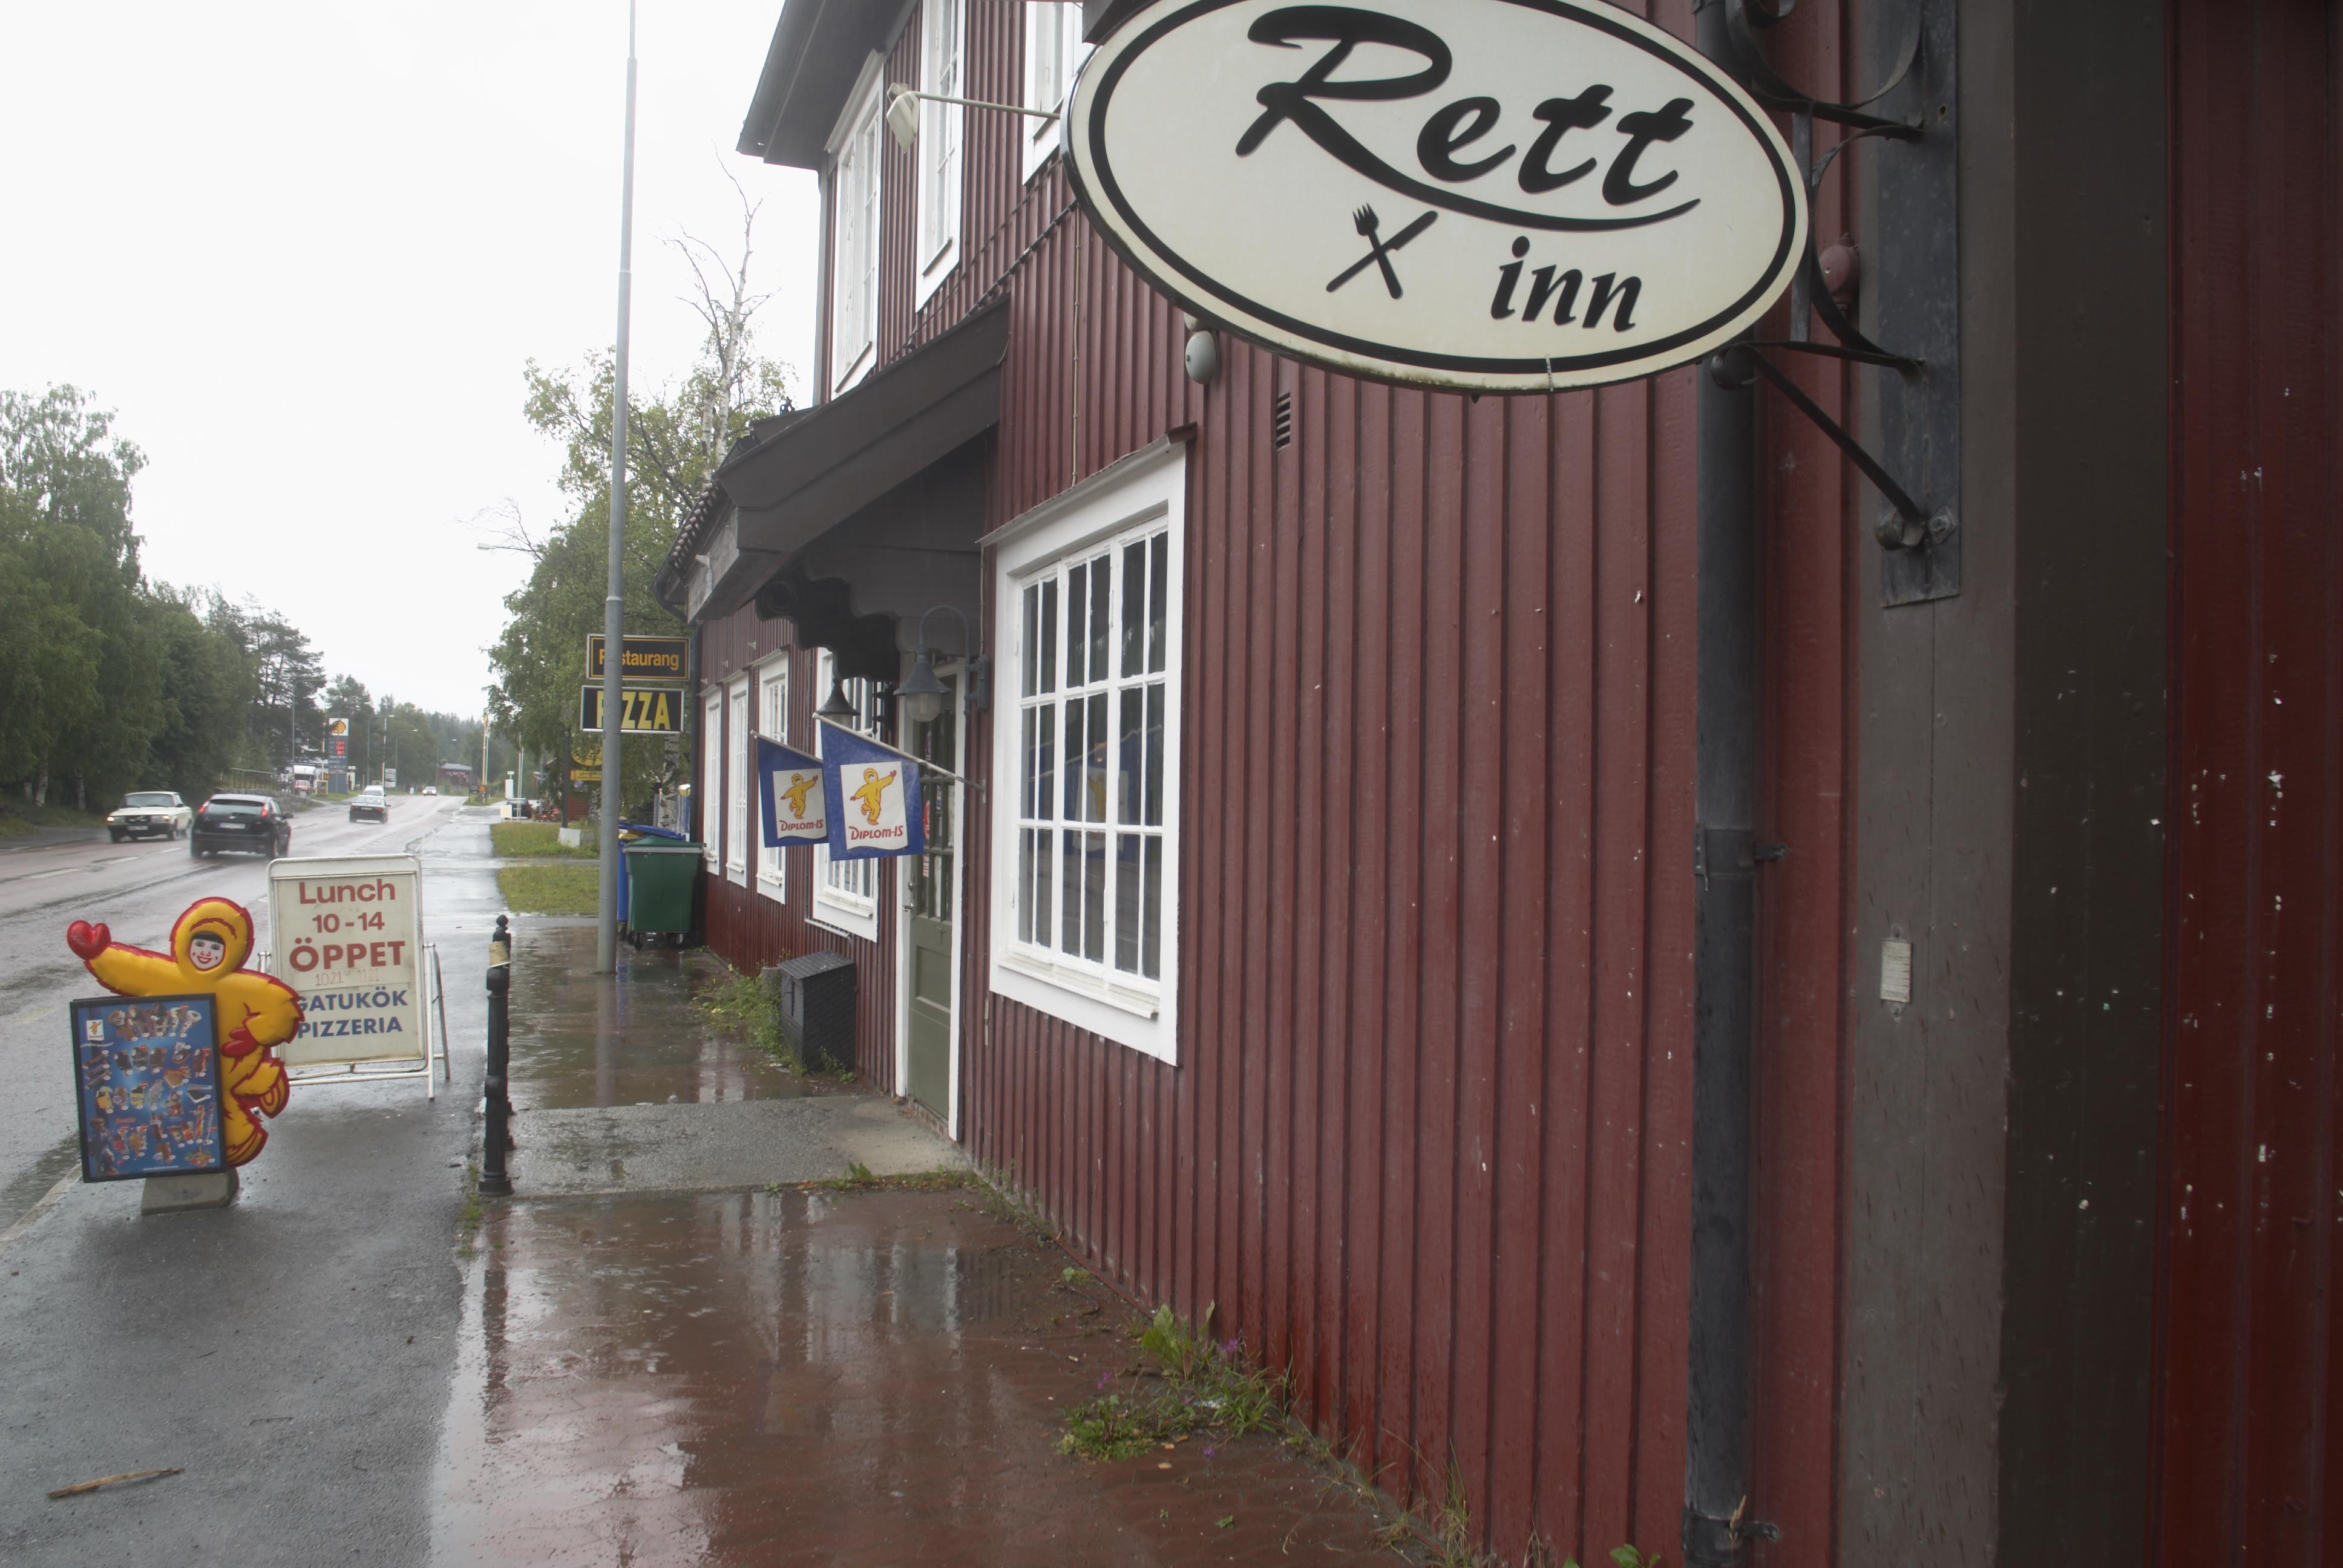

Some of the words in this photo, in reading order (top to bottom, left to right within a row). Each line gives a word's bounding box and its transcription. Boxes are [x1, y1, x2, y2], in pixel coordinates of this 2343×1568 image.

[1235, 5, 1701, 232] Rett
[1490, 236, 1642, 333] inn
[599, 648, 679, 671] staurang
[597, 691, 670, 730] PZZA
[299, 878, 395, 904] Lunch
[289, 936, 405, 972] ÖPPET
[298, 986, 408, 1013] GATUKÖK
[298, 1016, 403, 1039] PIZZERIA
